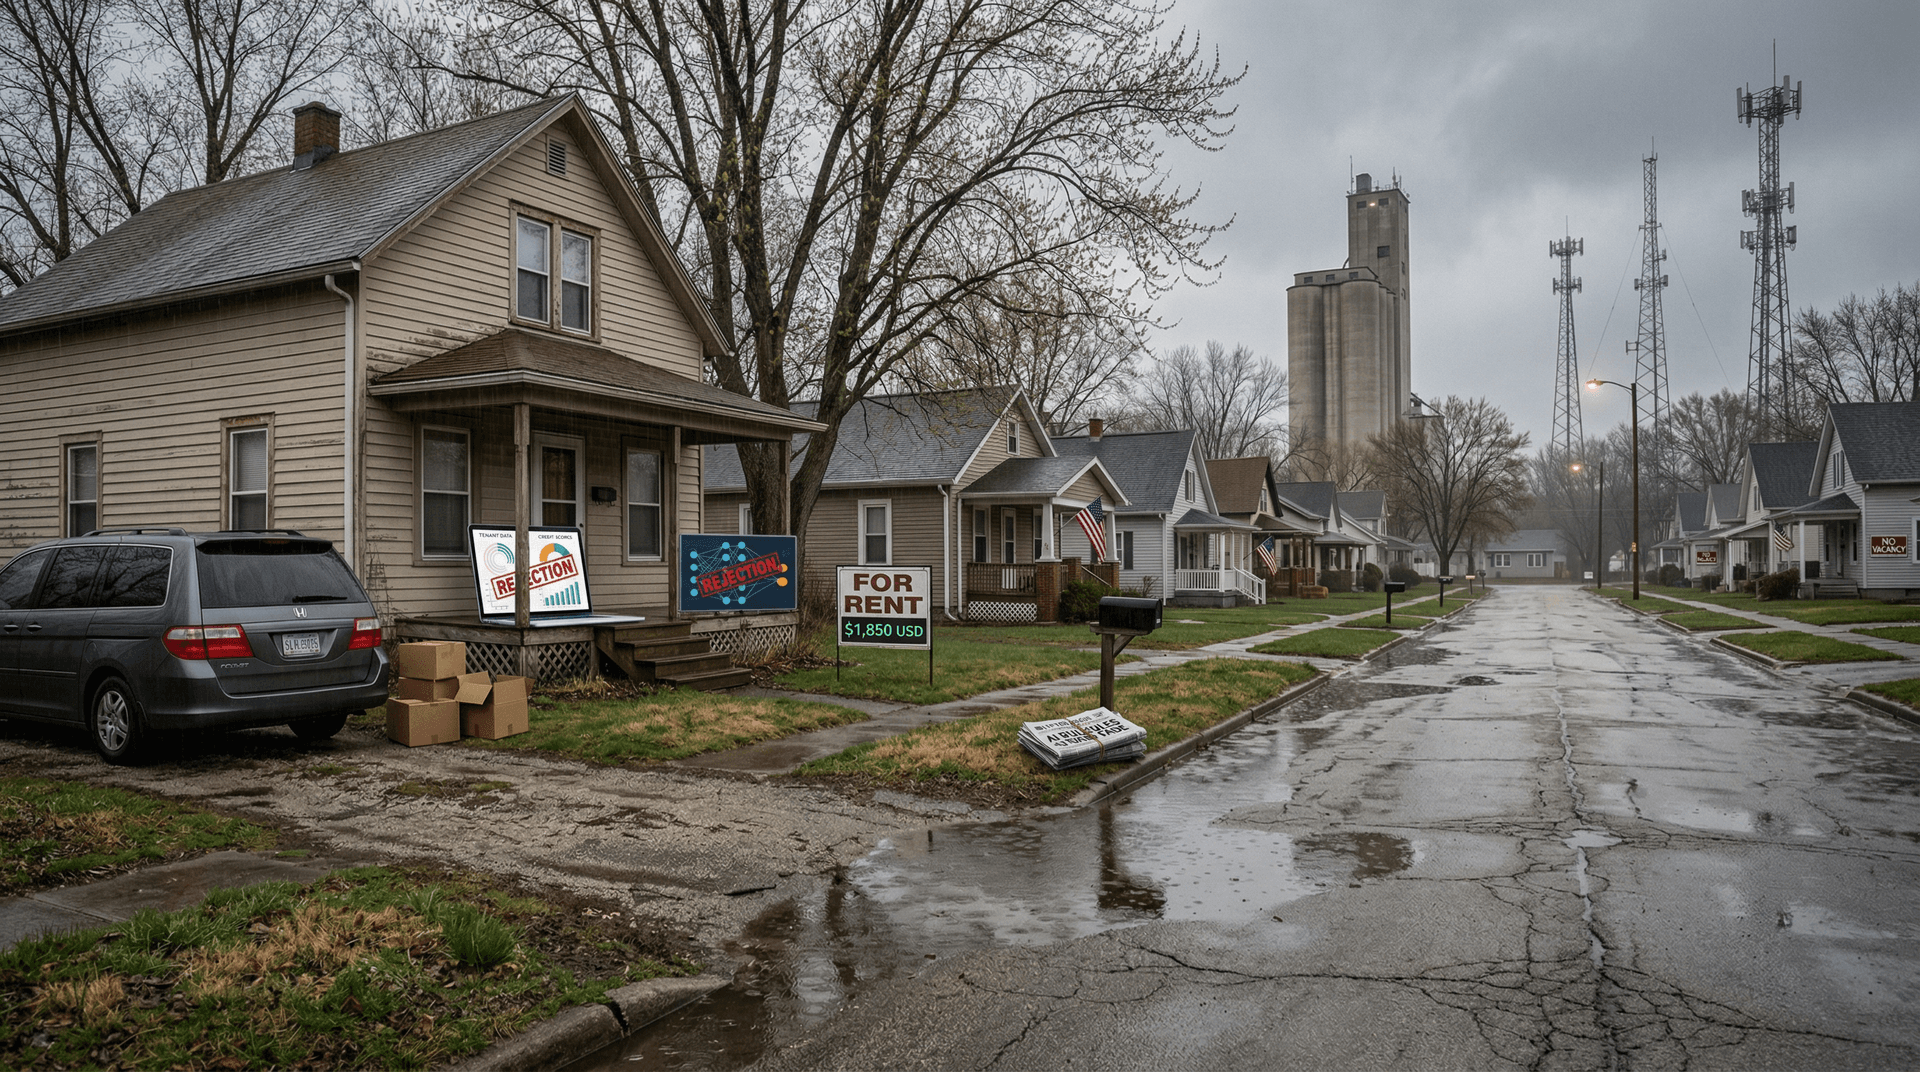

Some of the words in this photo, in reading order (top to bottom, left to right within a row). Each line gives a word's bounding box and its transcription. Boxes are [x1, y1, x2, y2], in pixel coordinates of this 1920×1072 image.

[1872, 545, 1906, 553] VACANCY
[1881, 537, 1896, 546] NO
[496, 559, 573, 595] RECTION
[701, 557, 777, 593] REJECTION
[853, 573, 912, 592] FOR
[844, 595, 923, 614] RENT
[845, 621, 892, 638] $1,850
[896, 625, 923, 637] USD
